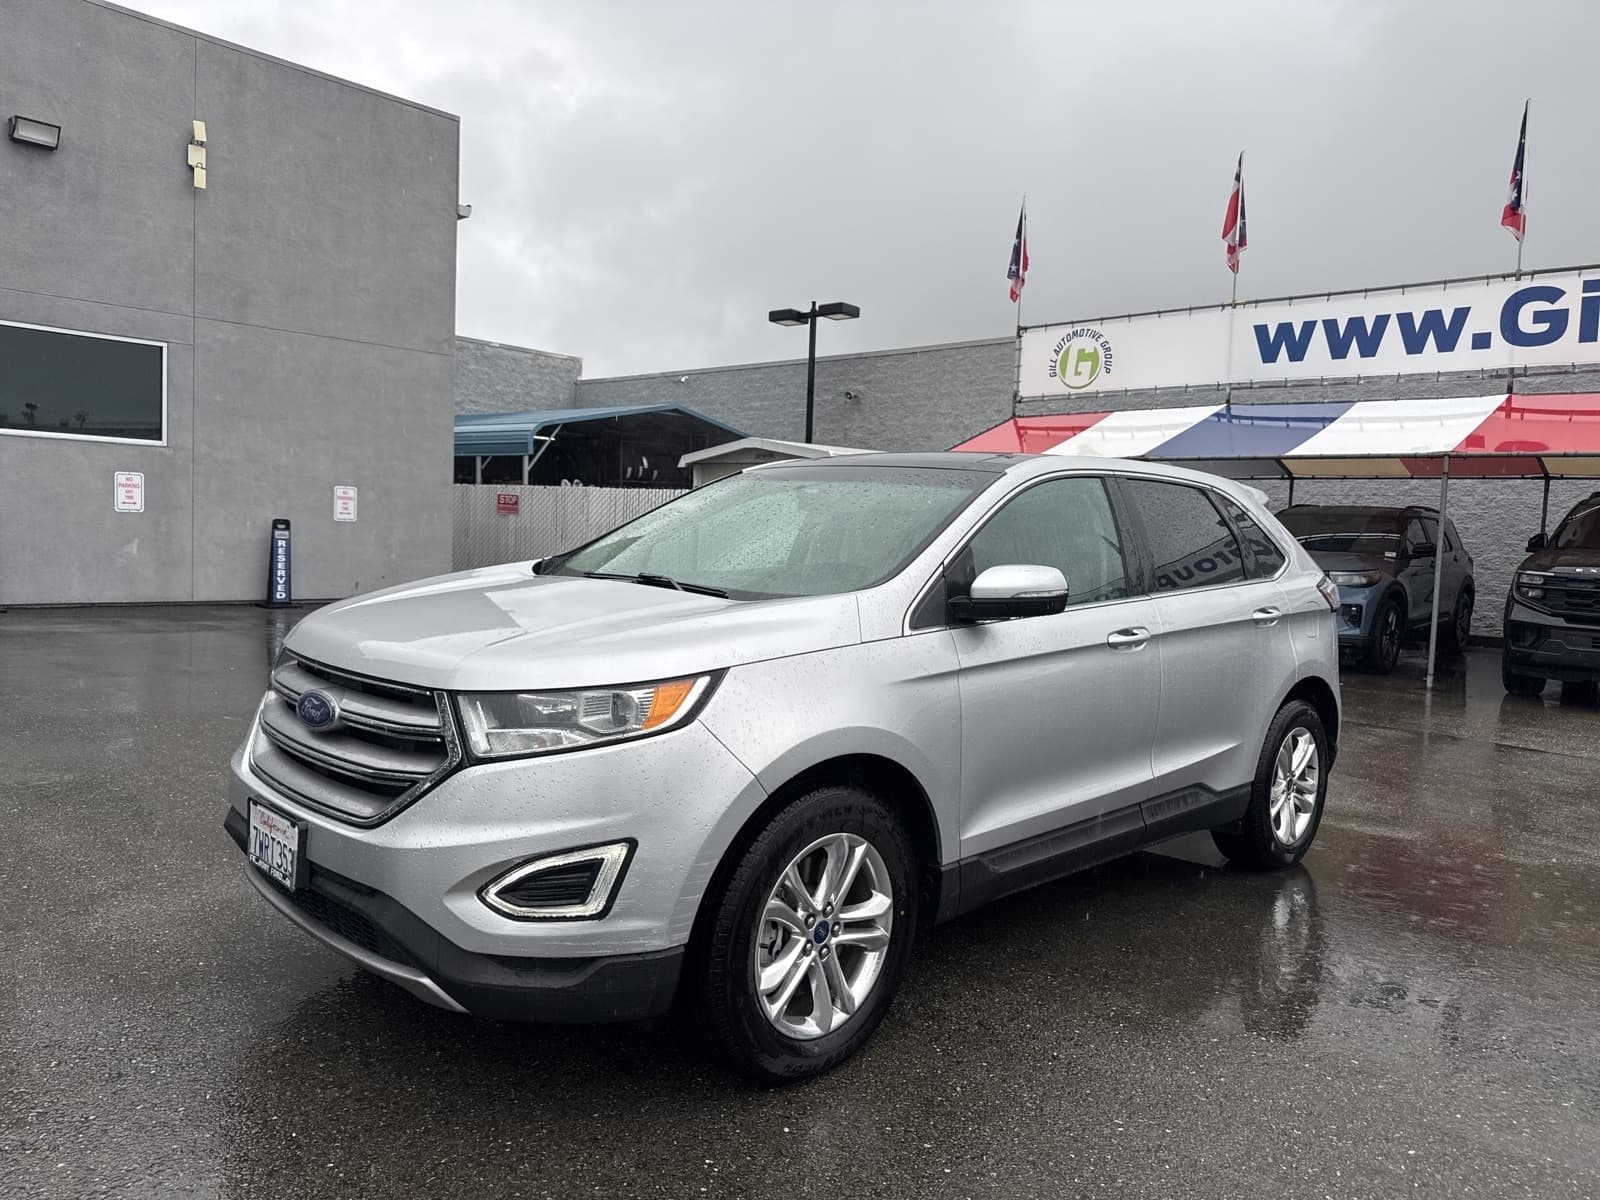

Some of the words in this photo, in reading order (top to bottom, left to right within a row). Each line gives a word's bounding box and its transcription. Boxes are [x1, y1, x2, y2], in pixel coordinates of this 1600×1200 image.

[1048, 358, 1058, 378] GILL
[1053, 328, 1104, 357] AUTOMOTIVE
[1100, 340, 1113, 374] GROUP
[499, 495, 518, 503] STOP
[276, 539, 287, 599] RESERVED
